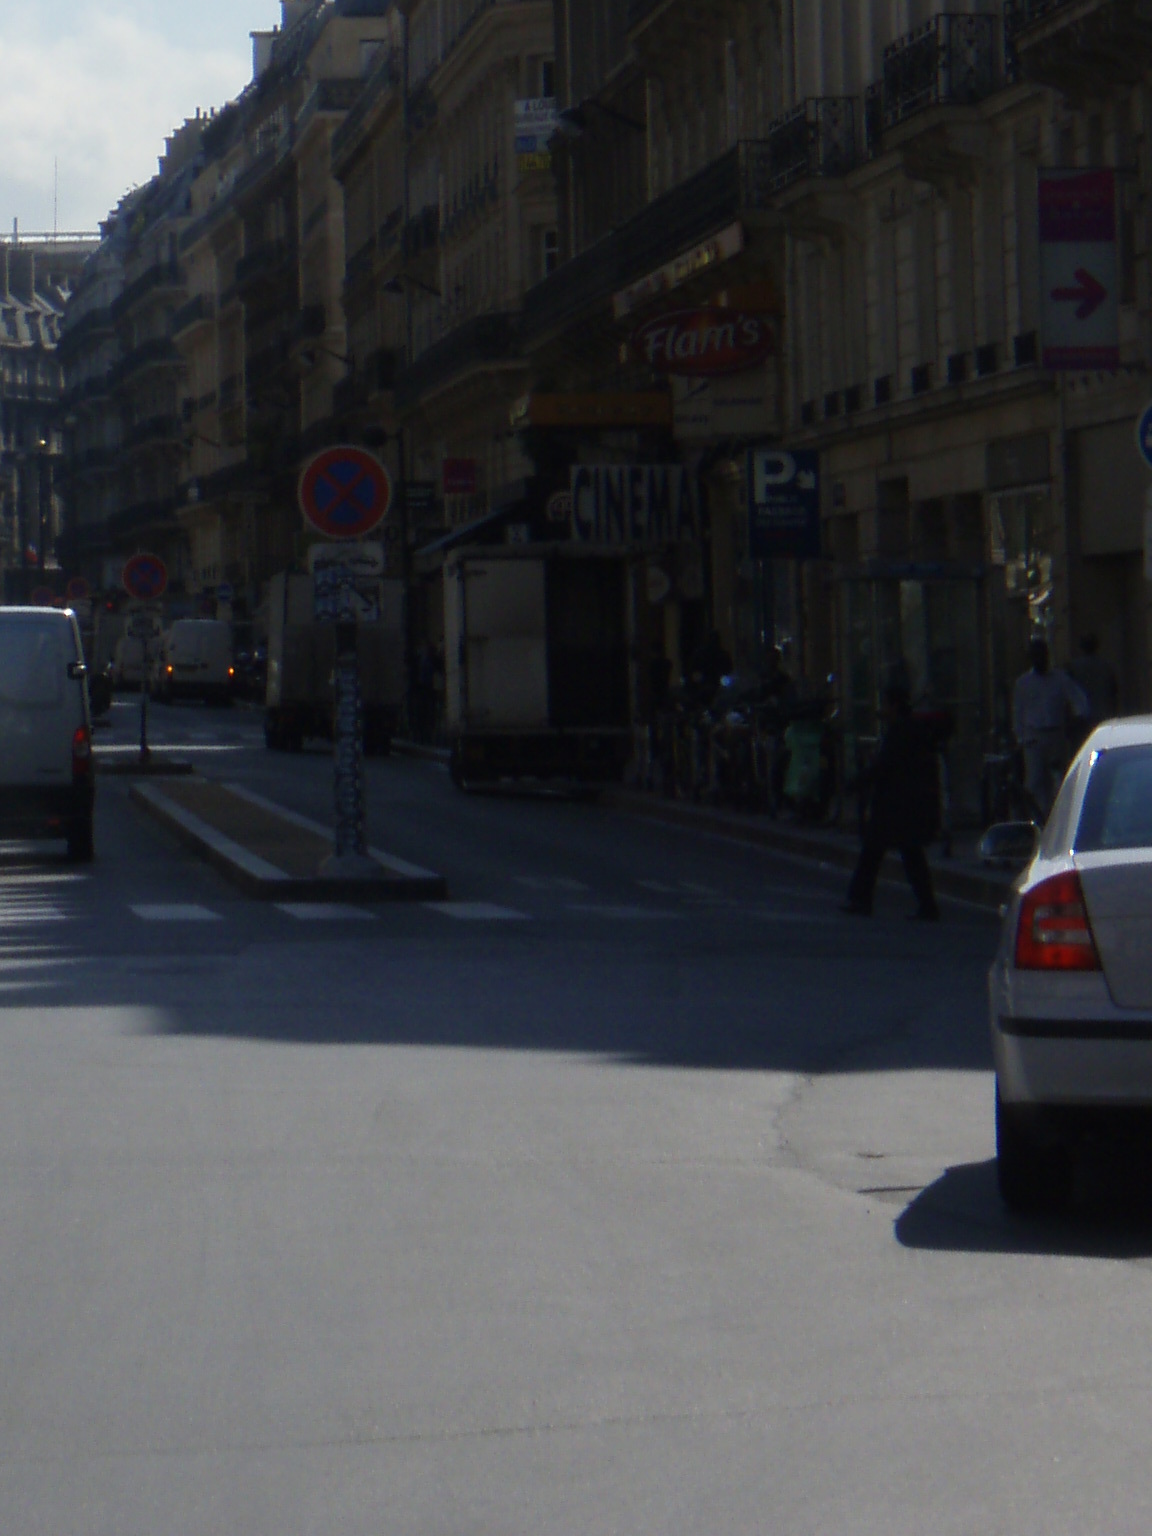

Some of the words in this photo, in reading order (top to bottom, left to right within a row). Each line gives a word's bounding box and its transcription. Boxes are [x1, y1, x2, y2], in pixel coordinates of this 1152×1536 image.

[645, 315, 760, 362] Flam's
[754, 450, 798, 504] P
[573, 467, 696, 542] CINEMA
